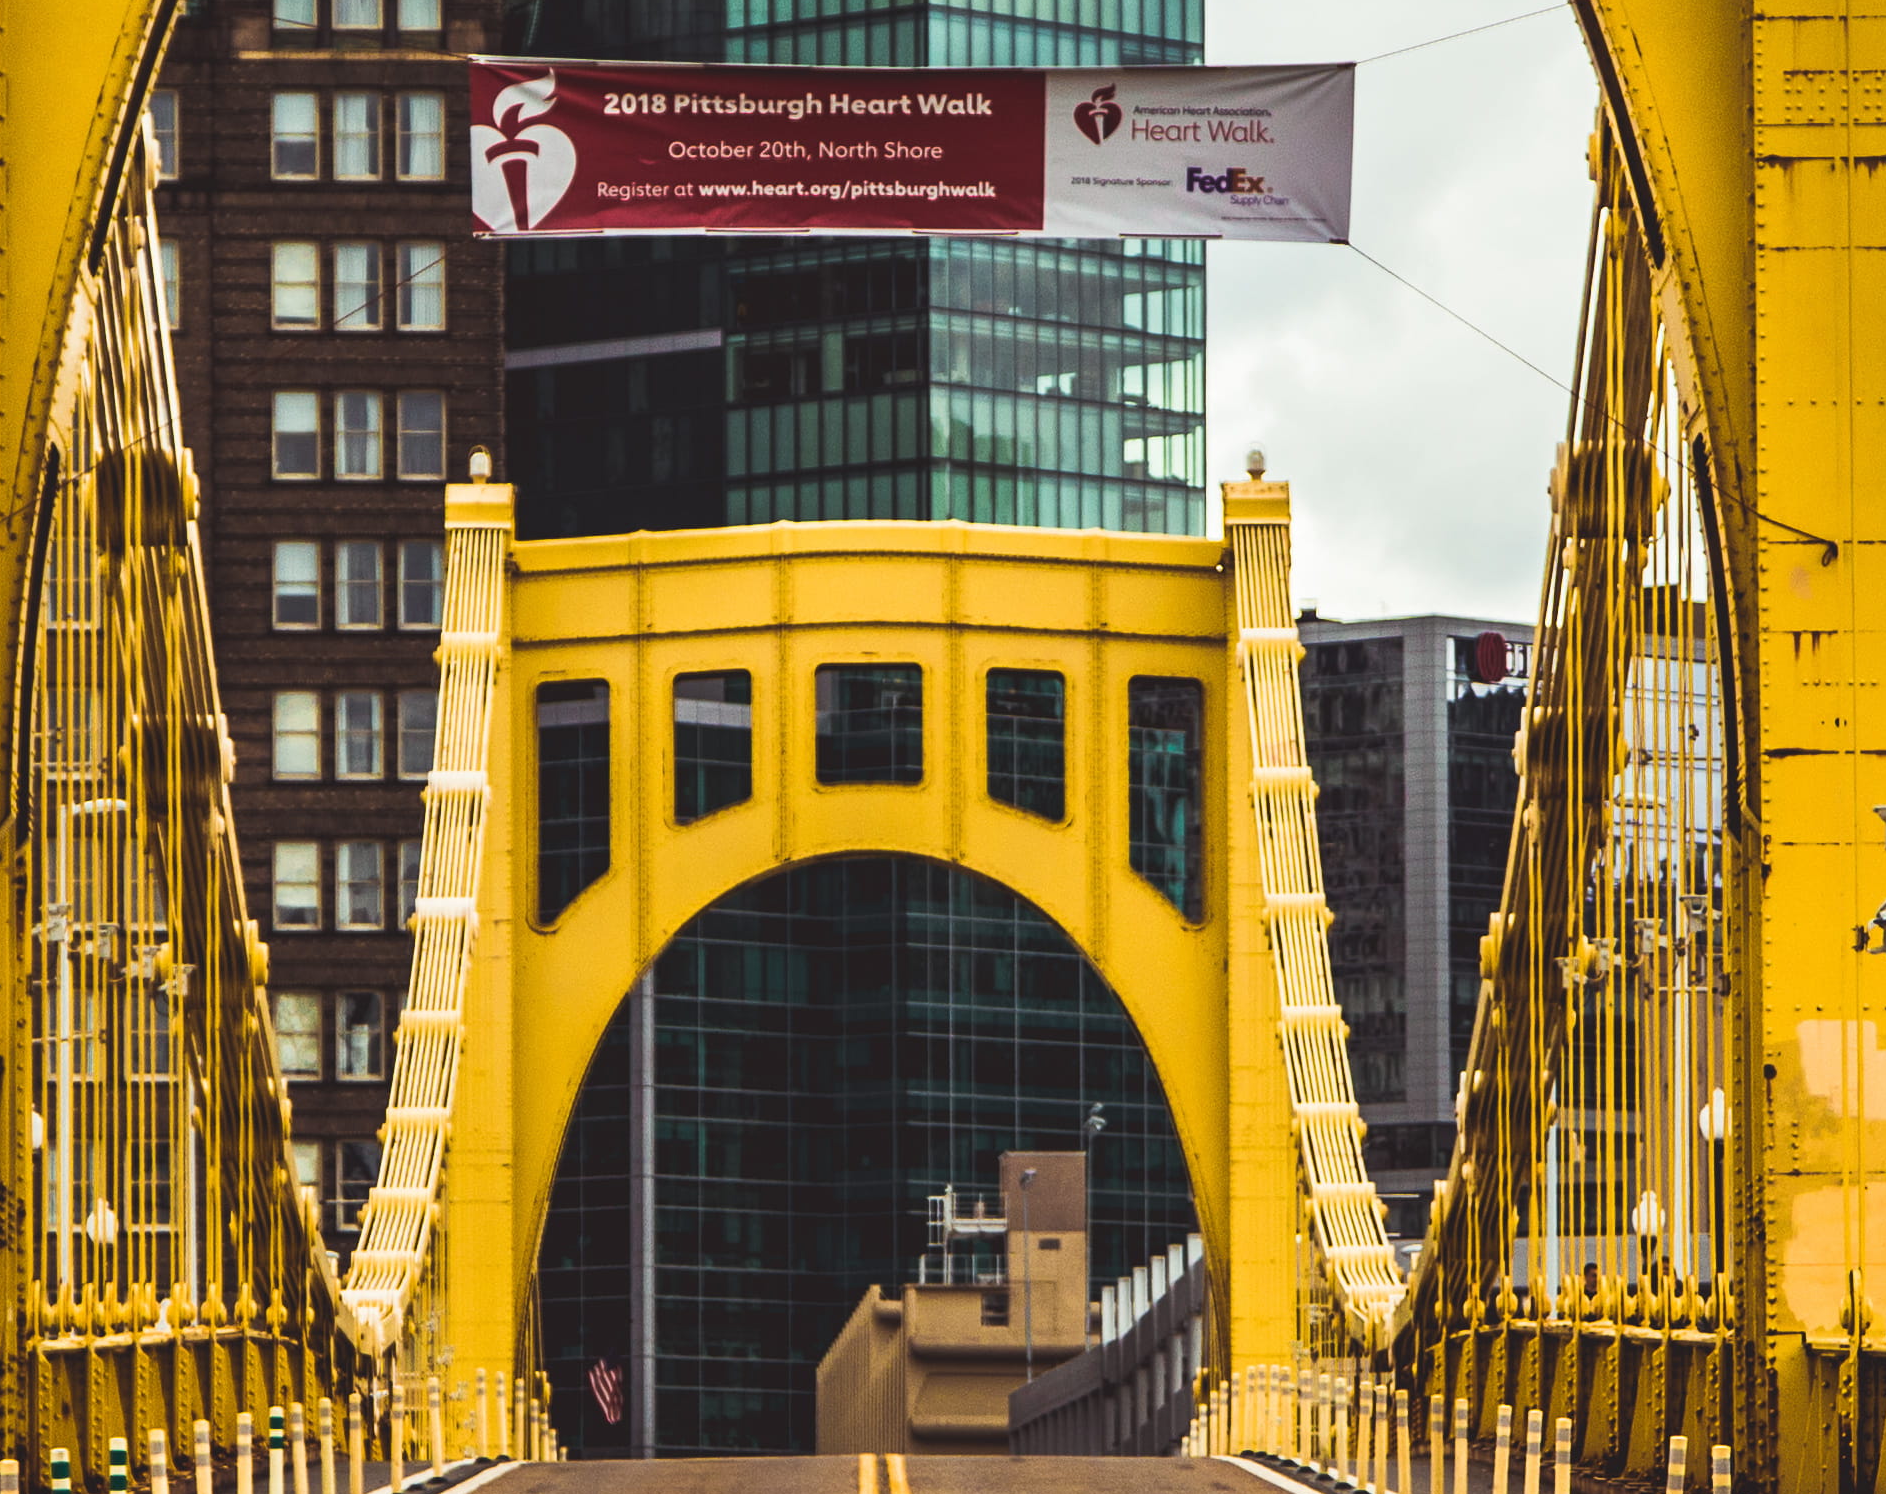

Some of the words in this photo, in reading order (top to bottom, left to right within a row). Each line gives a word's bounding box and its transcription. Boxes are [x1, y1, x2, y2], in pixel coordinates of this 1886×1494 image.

[603, 92, 667, 115] 2018
[674, 93, 822, 120] Pittsburgh
[829, 93, 911, 115] Heart
[917, 93, 993, 115] Walk
[1133, 105, 1180, 116] American
[1182, 106, 1211, 116] Heart
[1131, 119, 1200, 142] Heart
[668, 140, 754, 159] October
[759, 140, 811, 161] 20th,
[818, 140, 879, 159] North
[884, 140, 943, 159] Shore
[597, 181, 669, 201] Register
[673, 182, 694, 197] at
[699, 180, 996, 201] www.heart.org/pittsburghwalk
[1071, 176, 1091, 186] 2018
[1092, 177, 1134, 187] Signature
[1230, 194, 1262, 207] Supply
